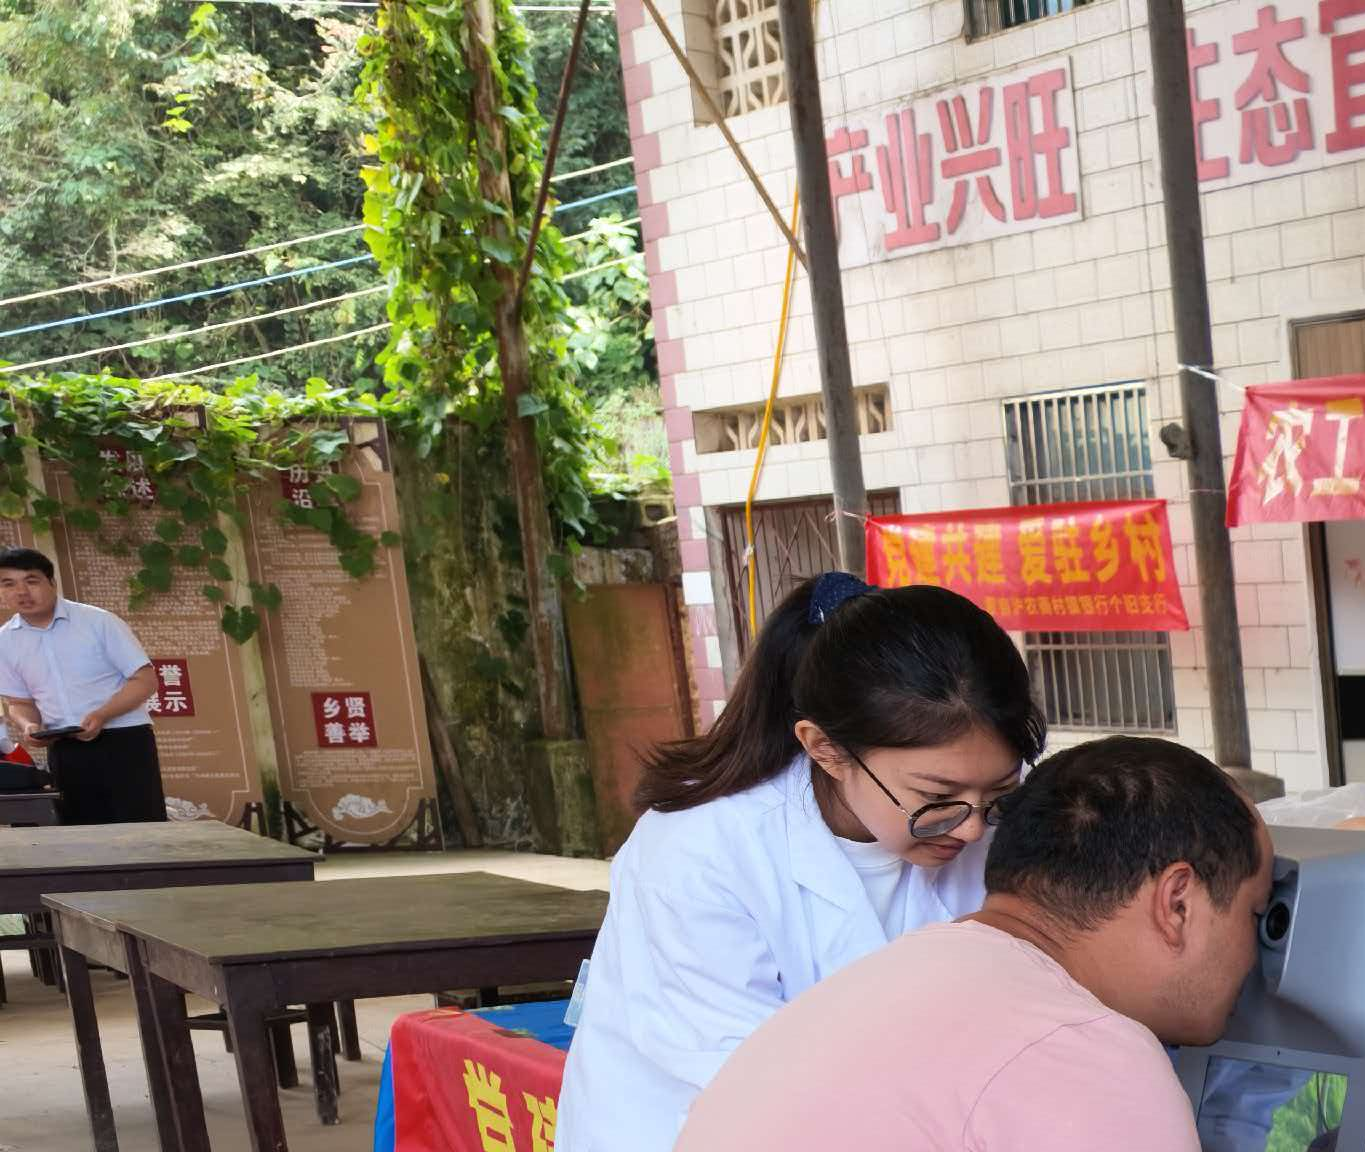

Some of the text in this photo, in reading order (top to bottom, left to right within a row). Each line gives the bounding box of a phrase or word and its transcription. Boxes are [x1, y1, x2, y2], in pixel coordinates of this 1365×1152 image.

[827, 67, 1078, 251] 产业兴旺
[323, 696, 367, 719] 乡贤
[324, 721, 370, 744] 善举
